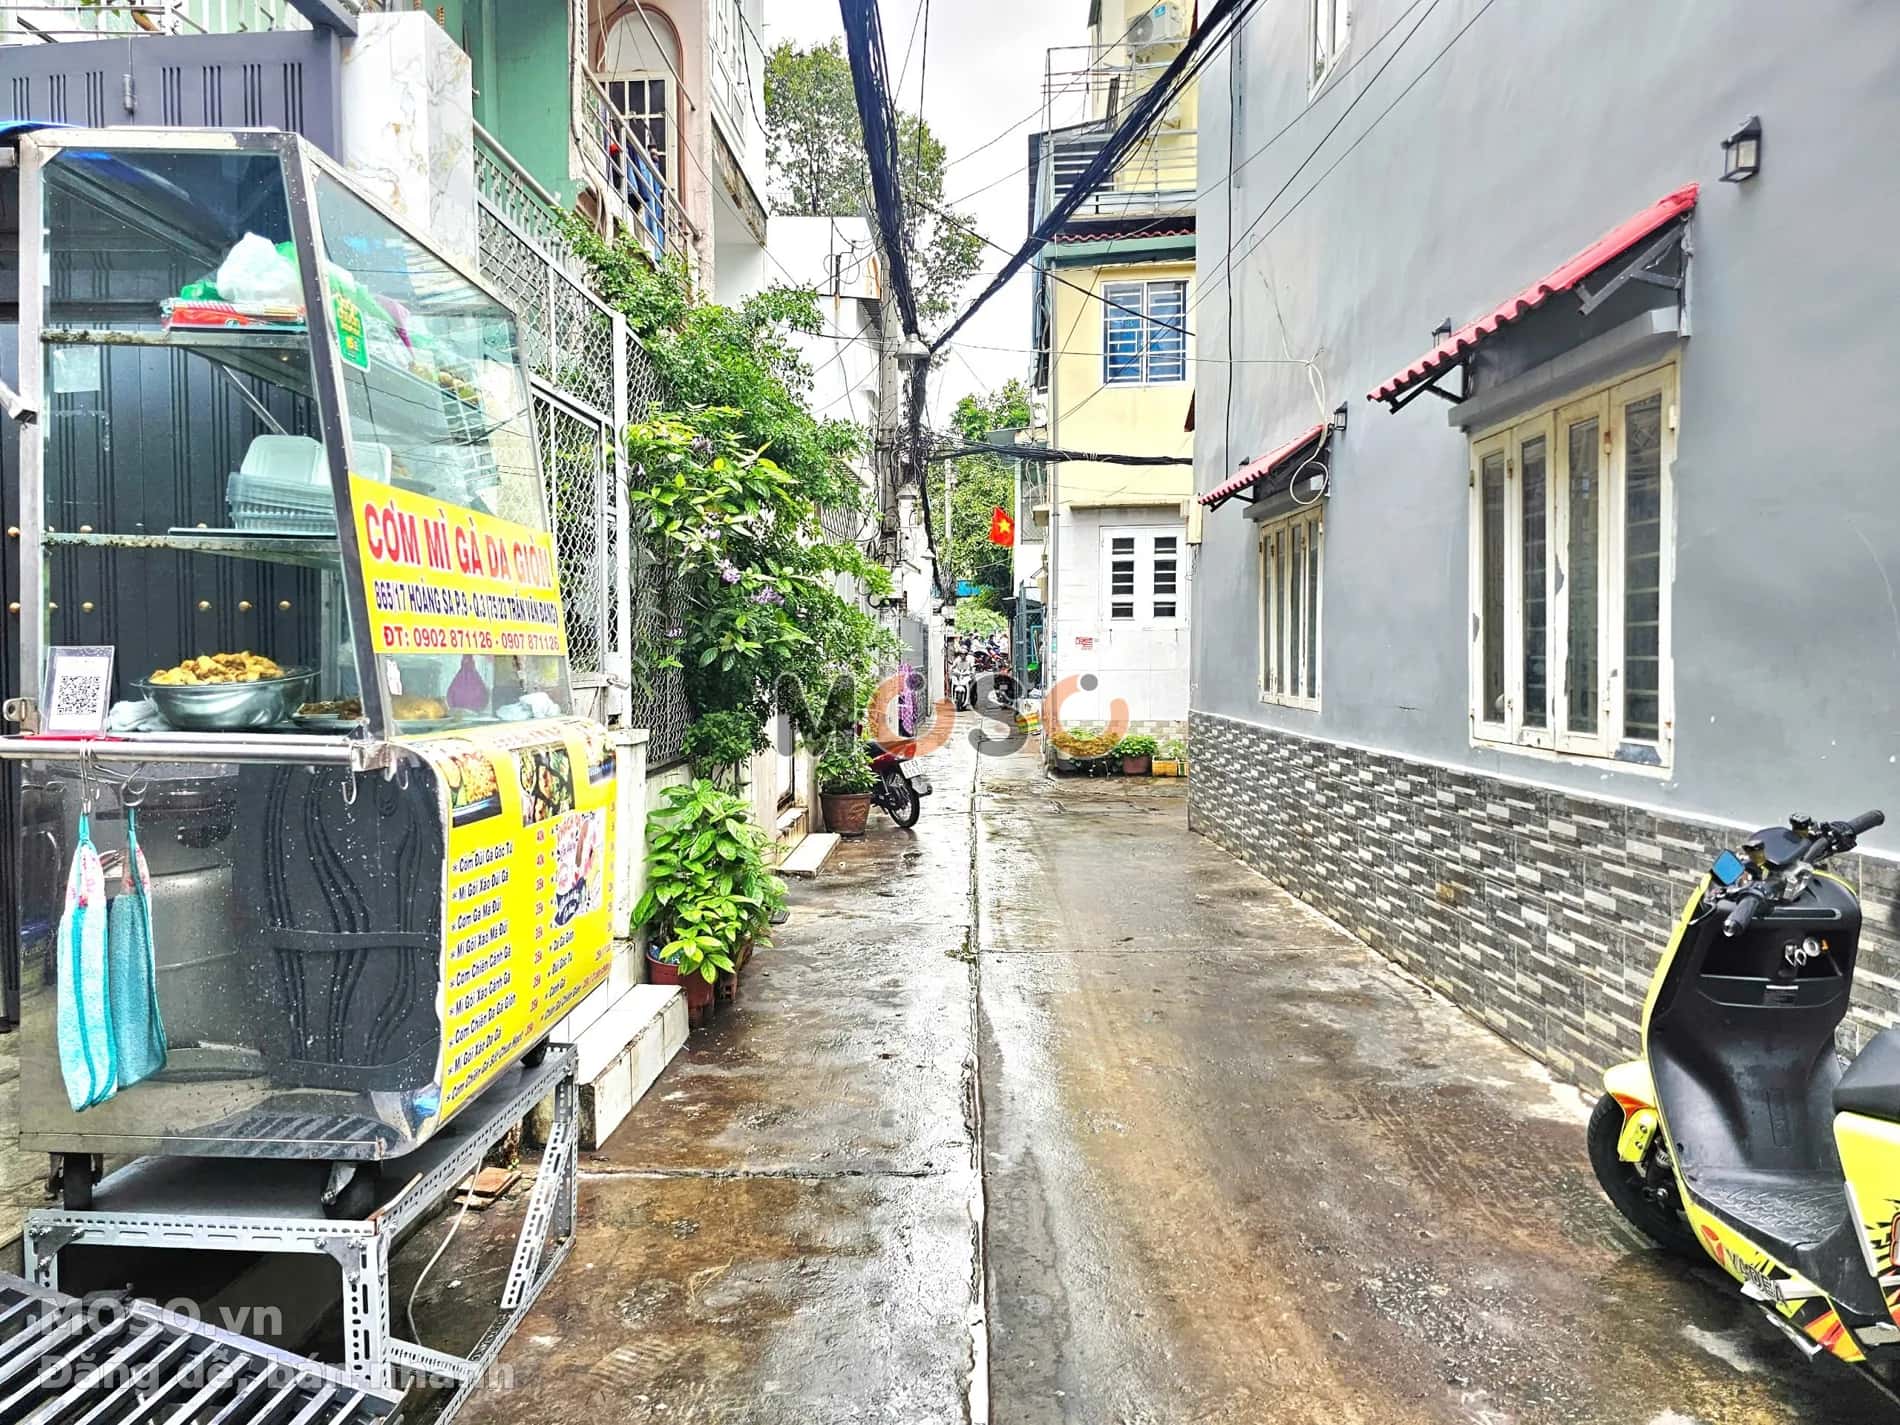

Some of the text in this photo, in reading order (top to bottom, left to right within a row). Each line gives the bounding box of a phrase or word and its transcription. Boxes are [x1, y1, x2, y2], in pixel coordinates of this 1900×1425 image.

[423, 508, 451, 570] MÌ
[455, 517, 484, 576] GÀ
[485, 534, 511, 580] DA
[384, 626, 409, 647] ĐT:
[413, 628, 447, 648] 0902
[450, 630, 492, 649] 871126
[501, 631, 525, 650] 0907
[528, 633, 560, 651] 871126
